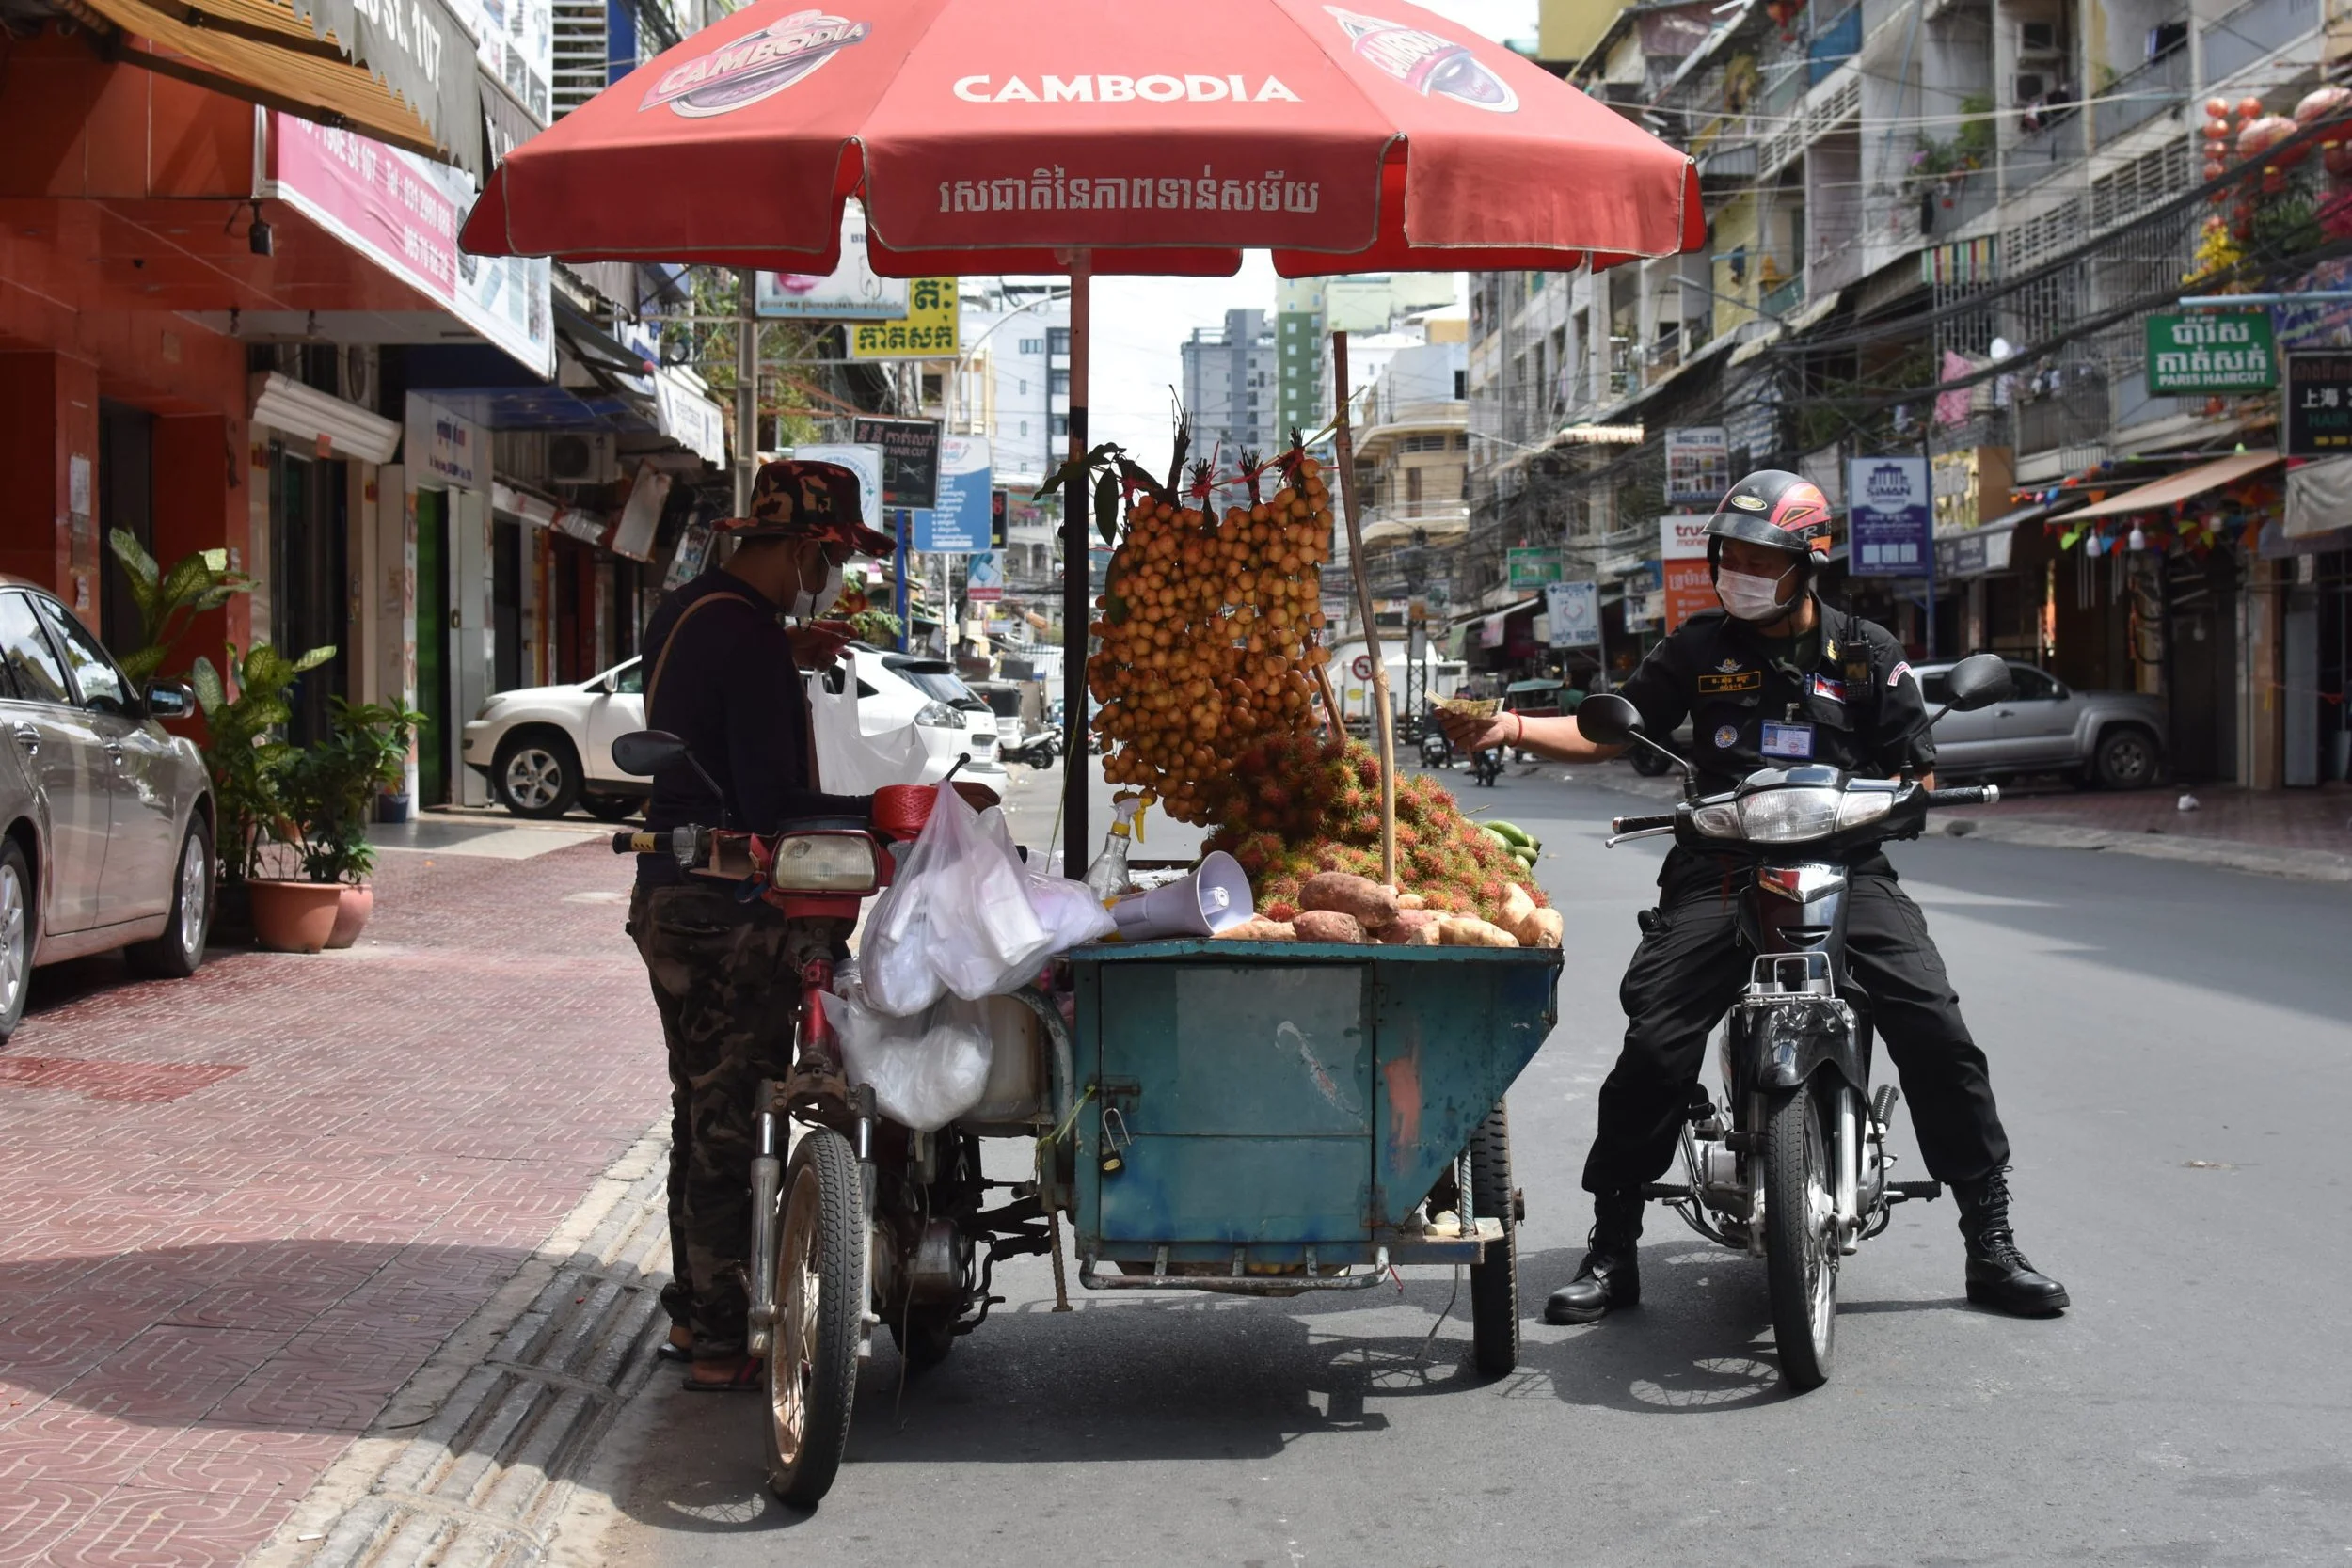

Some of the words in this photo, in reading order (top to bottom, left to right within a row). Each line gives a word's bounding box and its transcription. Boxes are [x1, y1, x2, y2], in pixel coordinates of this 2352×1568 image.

[411, 1, 441, 91] 107
[659, 23, 865, 93] CAMBODIA
[952, 74, 1304, 103] CAMBODIA
[2156, 342, 2267, 373] កាត់សក់
[2158, 372, 2201, 387] PARIS
[2202, 371, 2266, 385] HAIRCUT
[2301, 388, 2340, 408] 上海
[890, 447, 910, 456] HAIR
[912, 448, 928, 457] CUT
